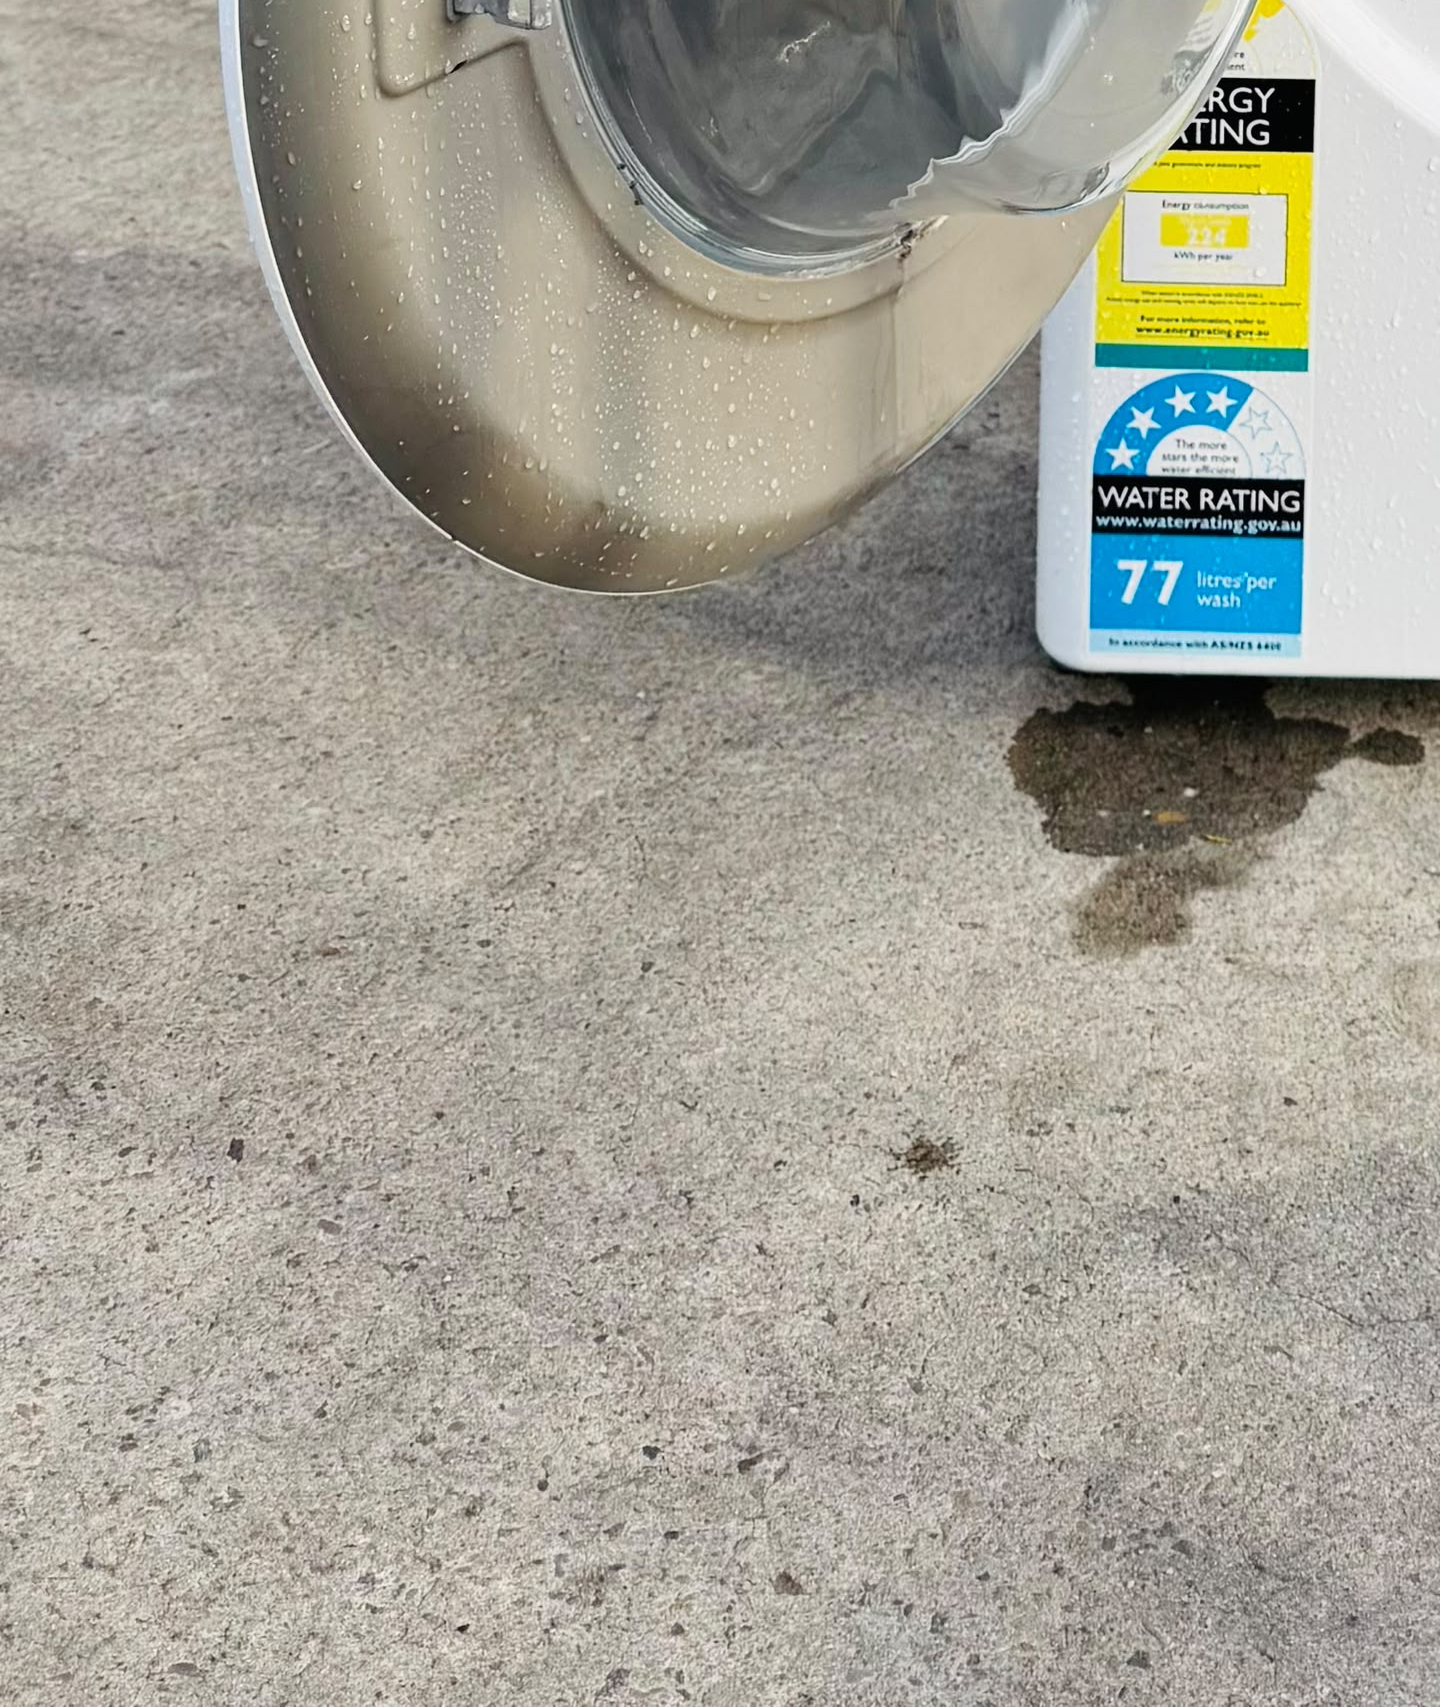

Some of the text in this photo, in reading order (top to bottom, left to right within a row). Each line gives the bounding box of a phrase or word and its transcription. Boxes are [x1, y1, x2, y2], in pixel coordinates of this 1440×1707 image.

[1197, 86, 1276, 114] RGY
[1180, 118, 1271, 146] TING
[1176, 438, 1228, 450] The more
[1162, 452, 1239, 463] stars the more
[1097, 485, 1301, 514] WATER RATING
[1096, 515, 1302, 535] www.waterrating.gov.au
[1117, 558, 1184, 606] 77
[1197, 570, 1277, 594] litres per
[1197, 591, 1242, 608] wash
